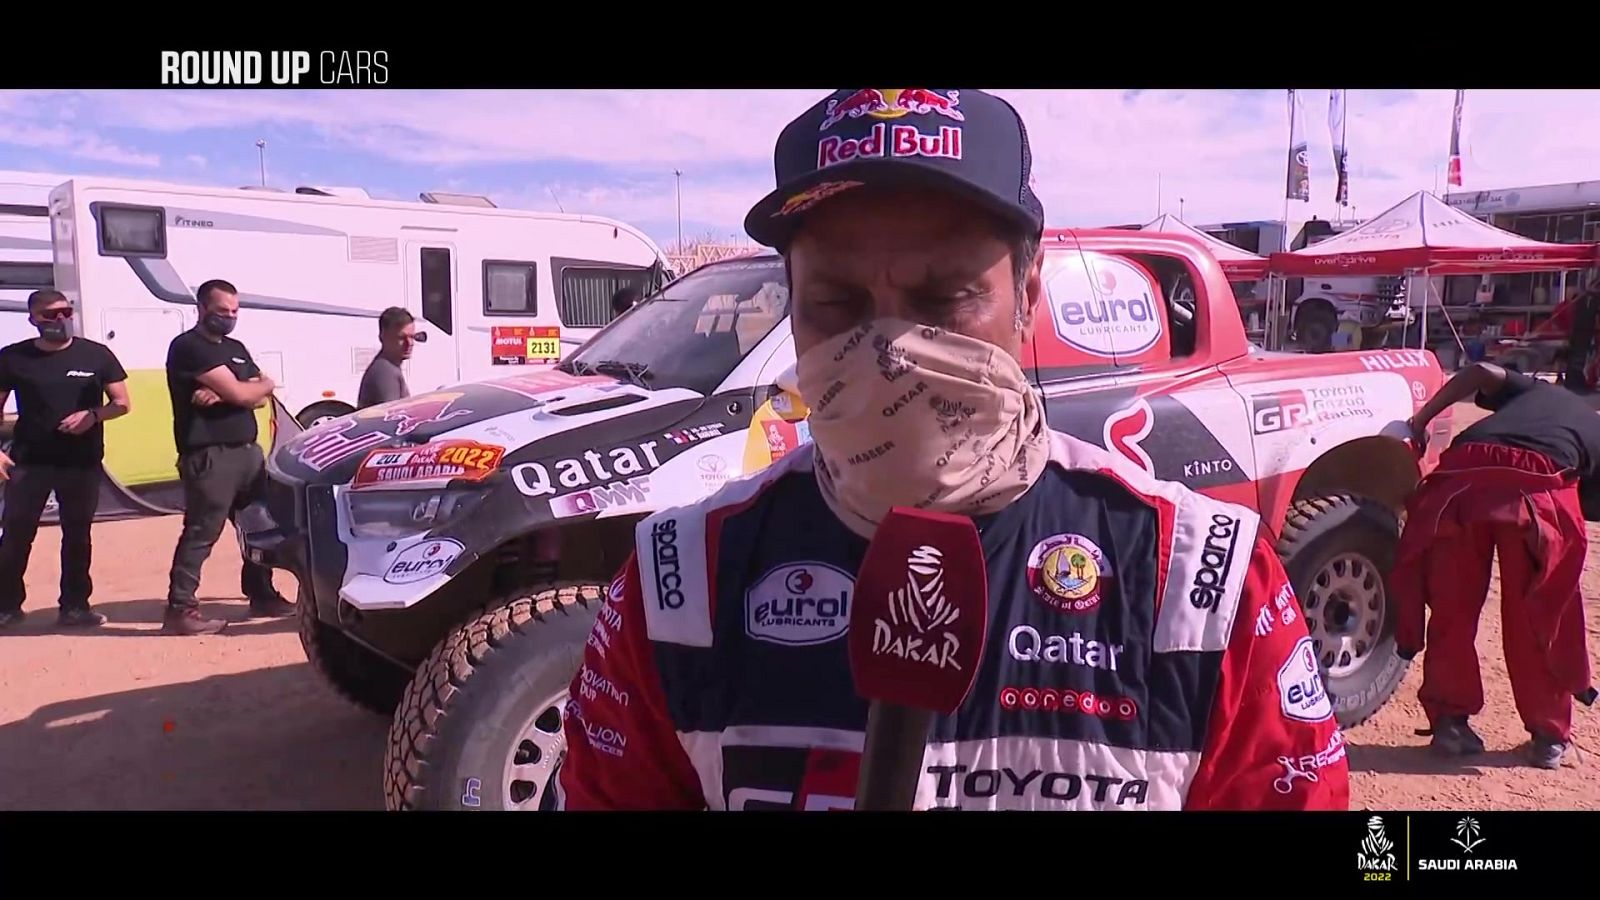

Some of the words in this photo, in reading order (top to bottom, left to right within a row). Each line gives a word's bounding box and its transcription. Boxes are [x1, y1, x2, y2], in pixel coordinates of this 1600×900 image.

[817, 123, 885, 170] Red
[891, 125, 961, 160] Bull
[1061, 292, 1154, 325] eurol
[494, 337, 524, 346] MOTUL
[531, 342, 556, 353] 2131
[1360, 351, 1430, 371] HILUX
[882, 381, 928, 417] QATAR
[1307, 385, 1365, 399] TOYOTA
[439, 447, 495, 471] 2022
[511, 440, 660, 496] Qatar
[651, 519, 685, 610] sparco
[1190, 514, 1240, 614] sparco
[754, 590, 848, 624] eurol
[762, 617, 836, 627] LUBRICANTS
[872, 617, 962, 672] DAKAR
[1008, 624, 1123, 671] Qatar
[1002, 688, 1136, 720] ooredoo
[926, 764, 1149, 806] TOYOTA
